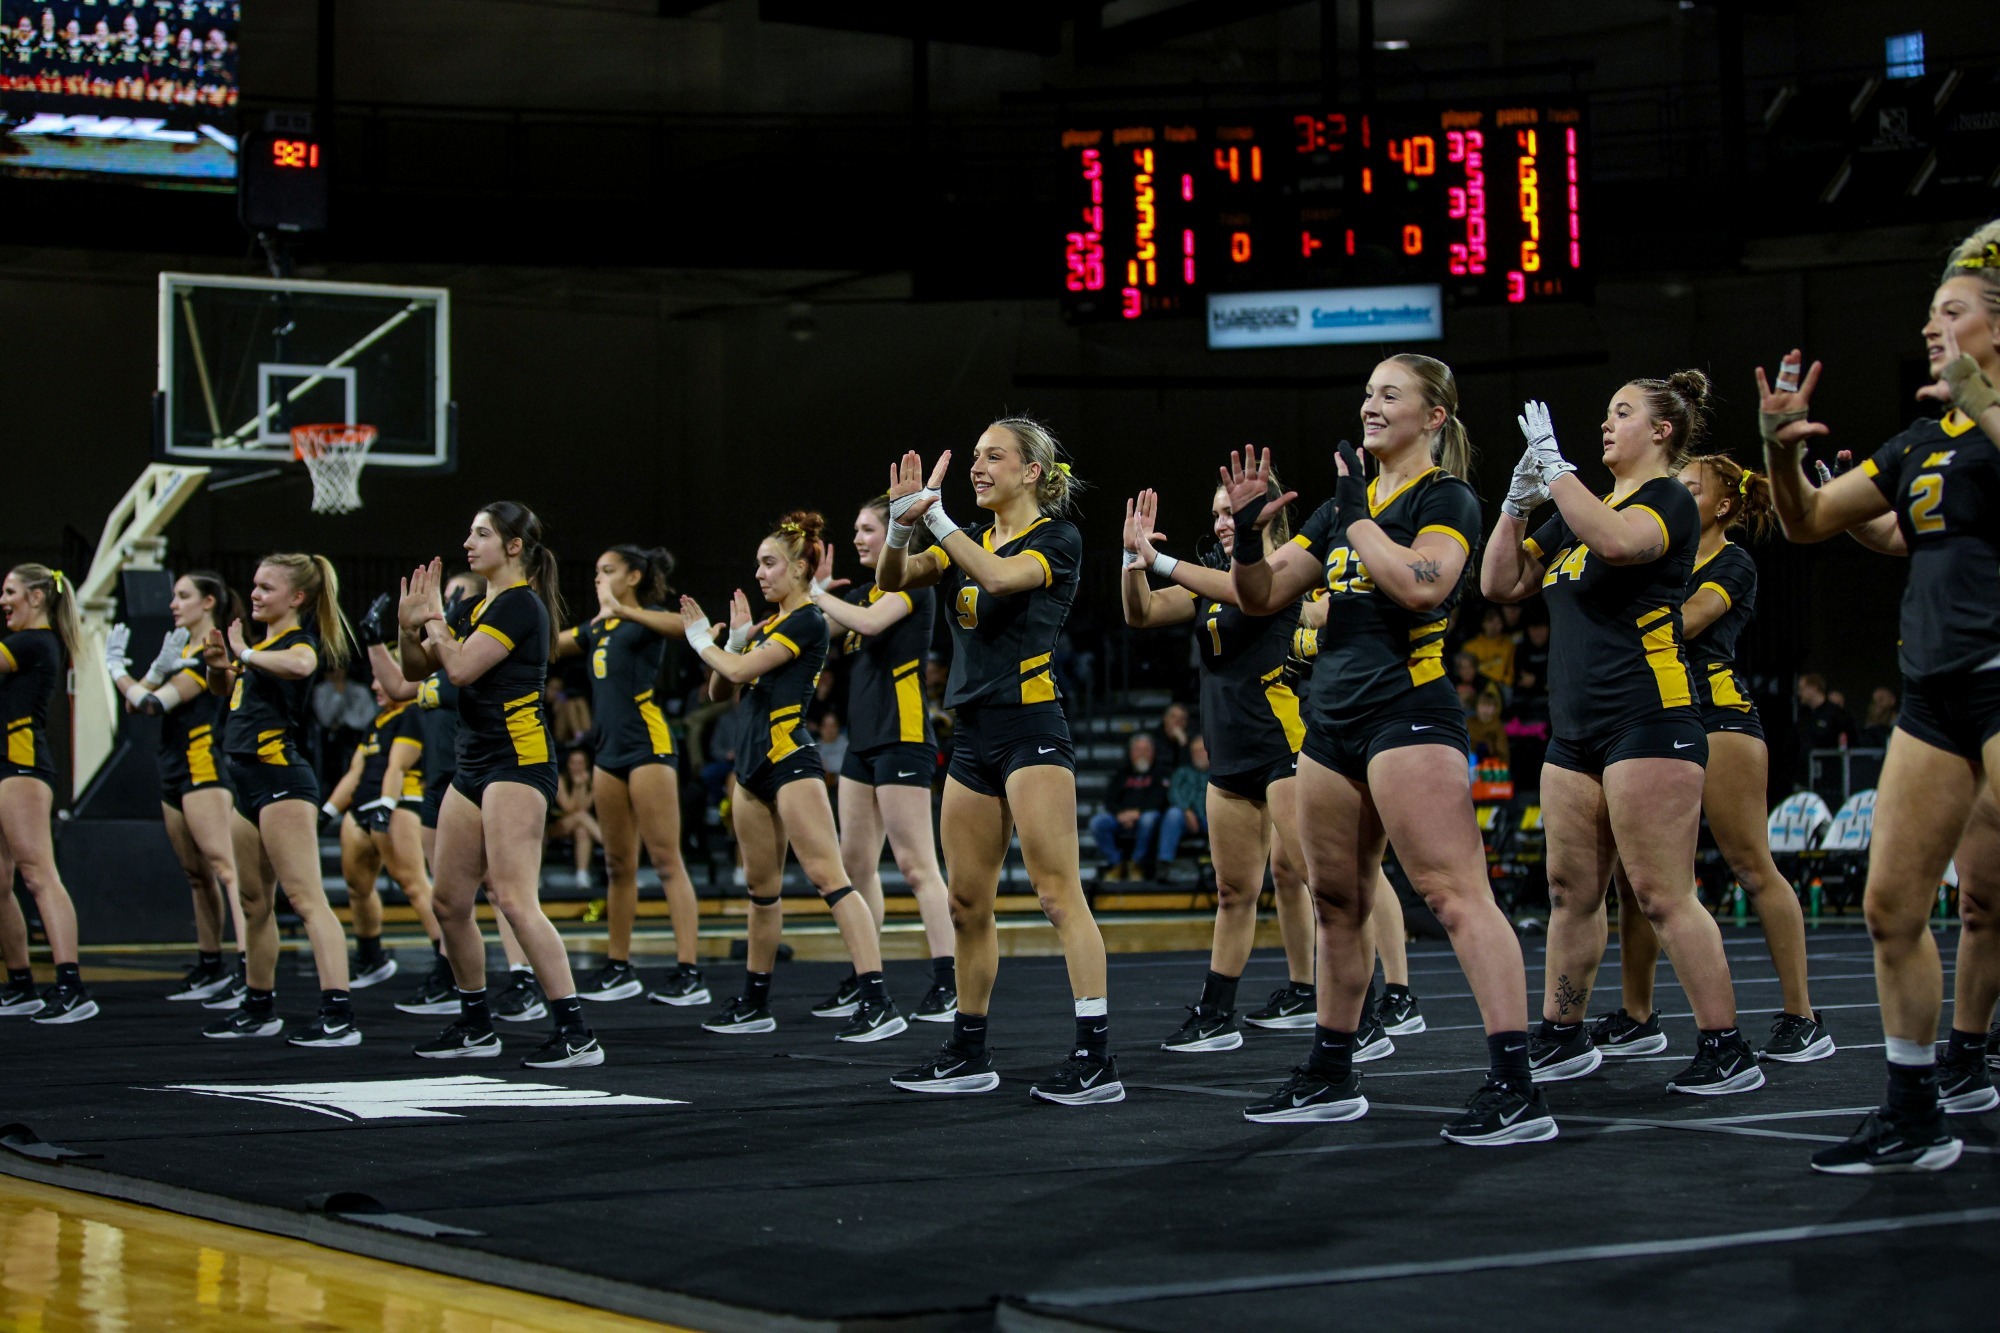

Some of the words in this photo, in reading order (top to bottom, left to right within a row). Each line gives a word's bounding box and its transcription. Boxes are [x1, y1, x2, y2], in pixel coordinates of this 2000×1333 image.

[1293, 114, 1371, 153] 3:21
[1082, 149, 1102, 179] 5
[1213, 145, 1264, 185] 41
[1386, 134, 1436, 177] 40
[1182, 174, 1193, 201] 1
[1361, 166, 1374, 195] 1
[1230, 231, 1253, 264] 0
[1401, 224, 1424, 257] 0
[1122, 287, 1142, 319] 3
[1507, 271, 1526, 303] 3
[1908, 472, 1947, 535] 2
[1542, 543, 1591, 588] 24
[956, 586, 980, 630] 9
[1206, 617, 1222, 656] 1
[592, 648, 608, 680] 6
